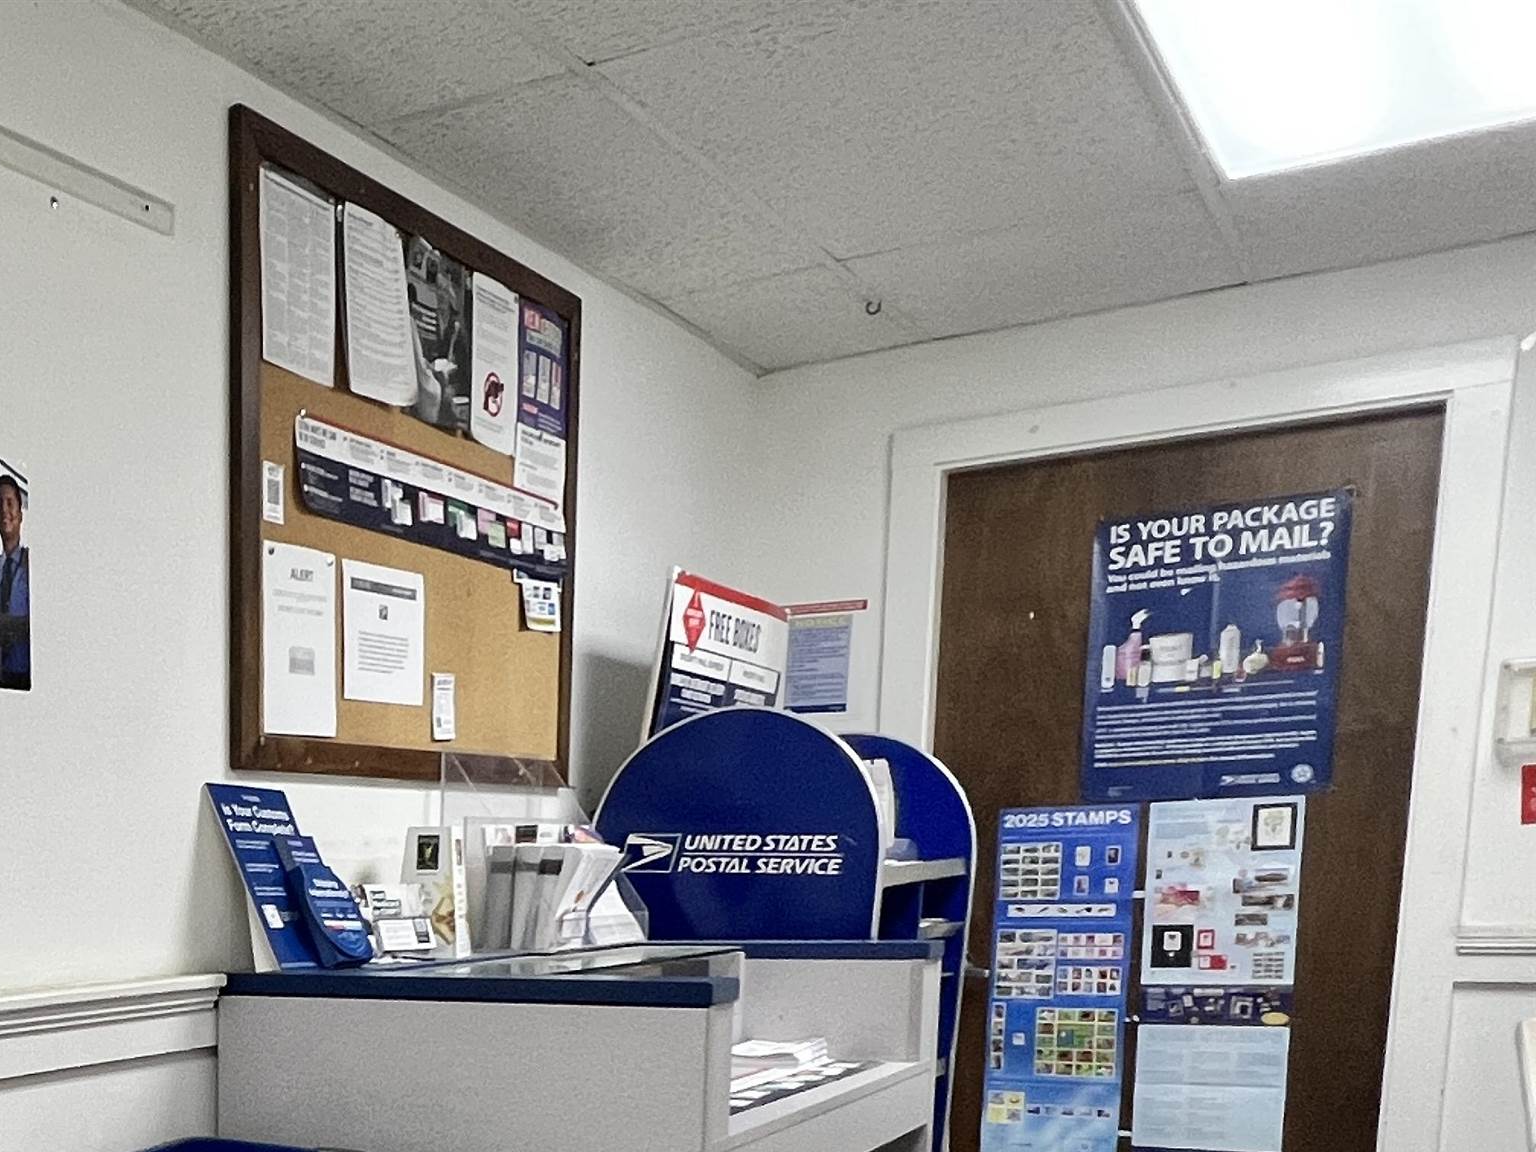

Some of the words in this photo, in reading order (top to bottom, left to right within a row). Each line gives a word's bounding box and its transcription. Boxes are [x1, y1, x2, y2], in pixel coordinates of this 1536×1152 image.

[1110, 523, 1131, 544] IS
[1136, 514, 1206, 541] YOUR
[1212, 497, 1336, 531] PACKAGE
[1108, 539, 1181, 570] SAFE
[1189, 534, 1233, 560] TO
[1239, 521, 1335, 555] MAIL?
[290, 568, 314, 582] ALERT
[708, 610, 732, 644] FREE
[733, 617, 762, 653] BOXES
[1003, 813, 1049, 829] 2025
[1050, 809, 1132, 826] STAMPS
[684, 834, 762, 851] UNITED
[765, 834, 839, 851] STATES
[678, 857, 751, 873] POSTAL
[755, 858, 843, 875] SERVICE
